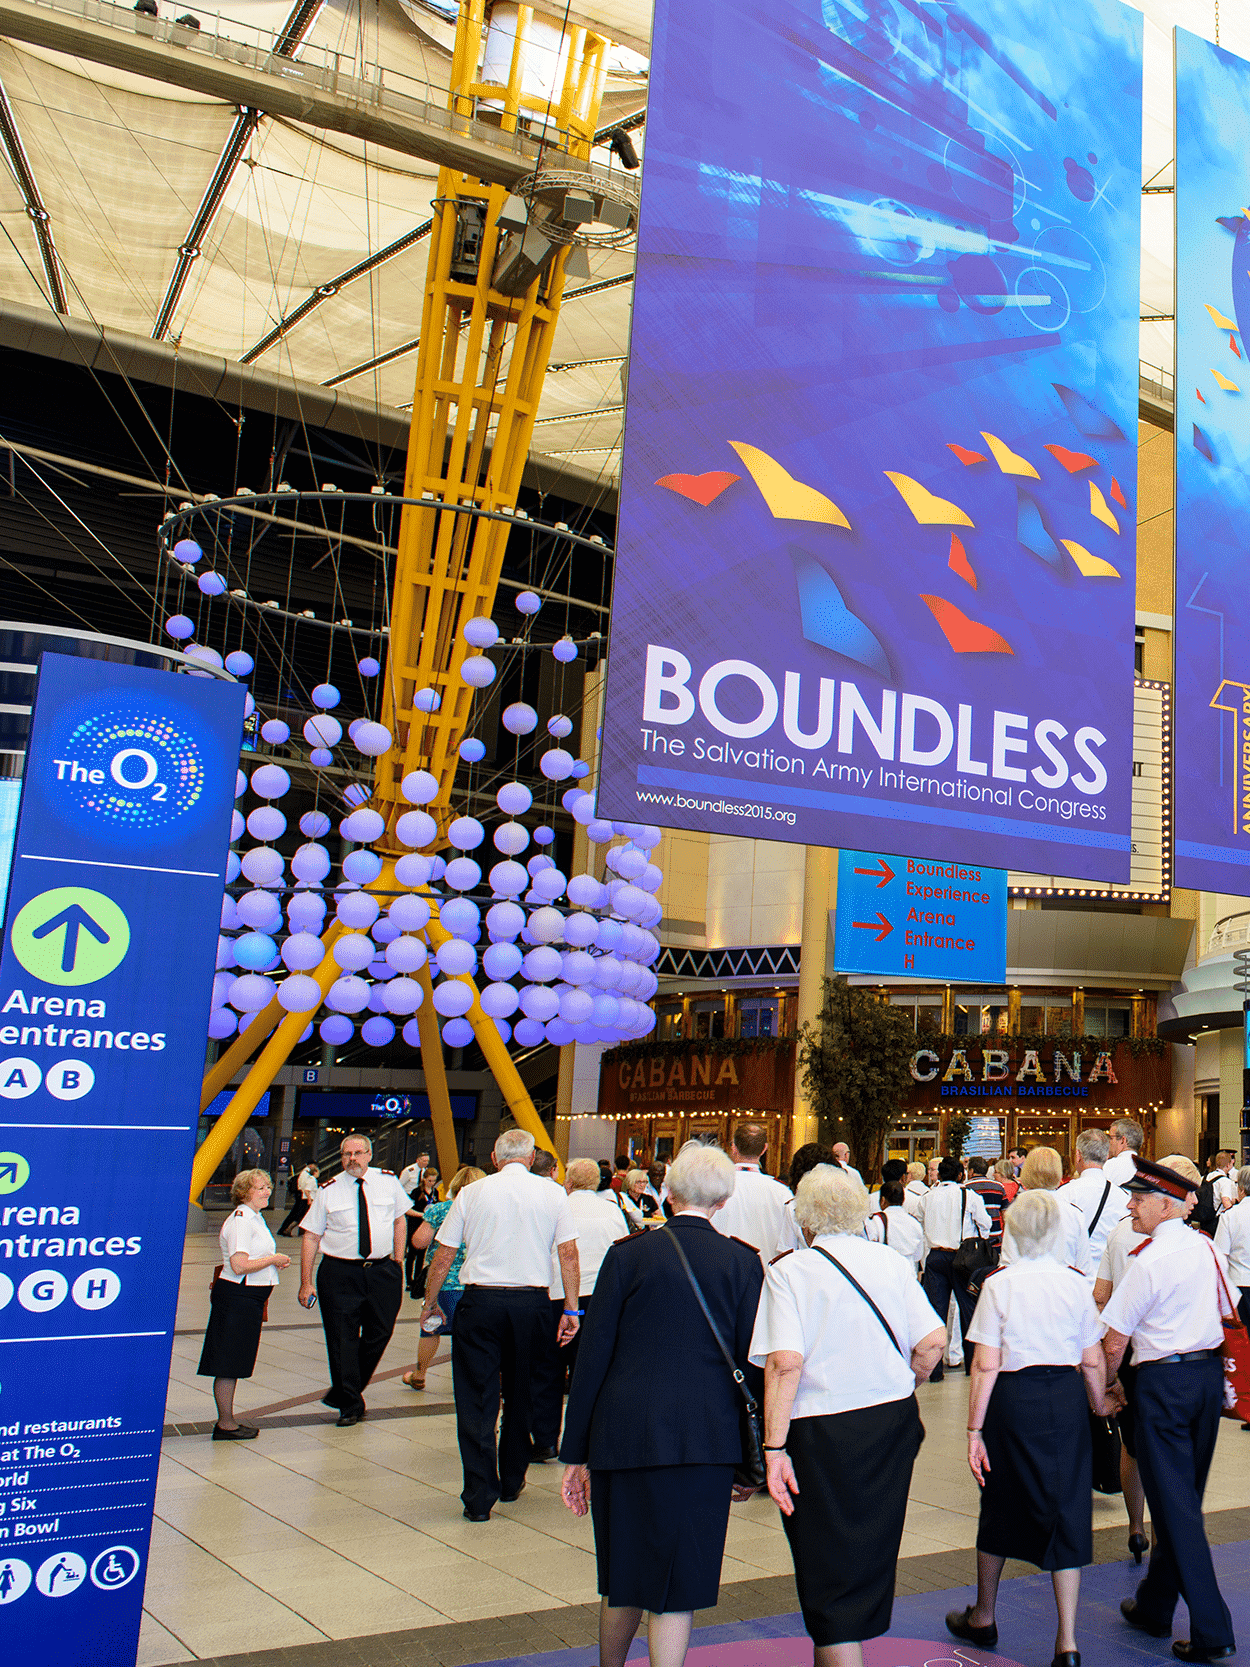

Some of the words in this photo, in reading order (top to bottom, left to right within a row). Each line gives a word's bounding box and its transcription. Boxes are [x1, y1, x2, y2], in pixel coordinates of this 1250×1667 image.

[642, 644, 1108, 795] BOUNDLESS
[53, 759, 106, 786] The
[640, 728, 686, 756] The
[692, 737, 806, 775] Salvation
[812, 757, 873, 789] Army
[879, 766, 1012, 806] International
[1018, 789, 1107, 821] Congress
[636, 790, 797, 826] www.boundless2015.org
[906, 859, 982, 882] Boundless
[905, 881, 990, 905] Experience
[906, 907, 956, 927] Arena
[905, 930, 976, 951] Entrance
[904, 954, 915, 970] H
[1, 989, 106, 1018] Arena
[0, 1023, 167, 1051] entrances
[306, 1070, 316, 1082] B
[618, 1053, 740, 1089] CABANA
[909, 1049, 1119, 1084] CABANA
[4, 1068, 28, 1088] A
[61, 1070, 81, 1089] B
[941, 1085, 1013, 1097] BRASILIAN
[1018, 1085, 1089, 1098] BARBECUE
[0, 1206, 80, 1226] rena
[0, 1233, 142, 1258] ntrances
[32, 1280, 55, 1301] G
[86, 1278, 108, 1299] H
[0, 1421, 20, 1437] nd
[24, 1415, 122, 1435] restaurants
[1, 1448, 20, 1462] at
[23, 1445, 56, 1460] The
[0, 1471, 30, 1488] orld
[10, 1497, 37, 1512] Six
[14, 1518, 60, 1537] Bowl
